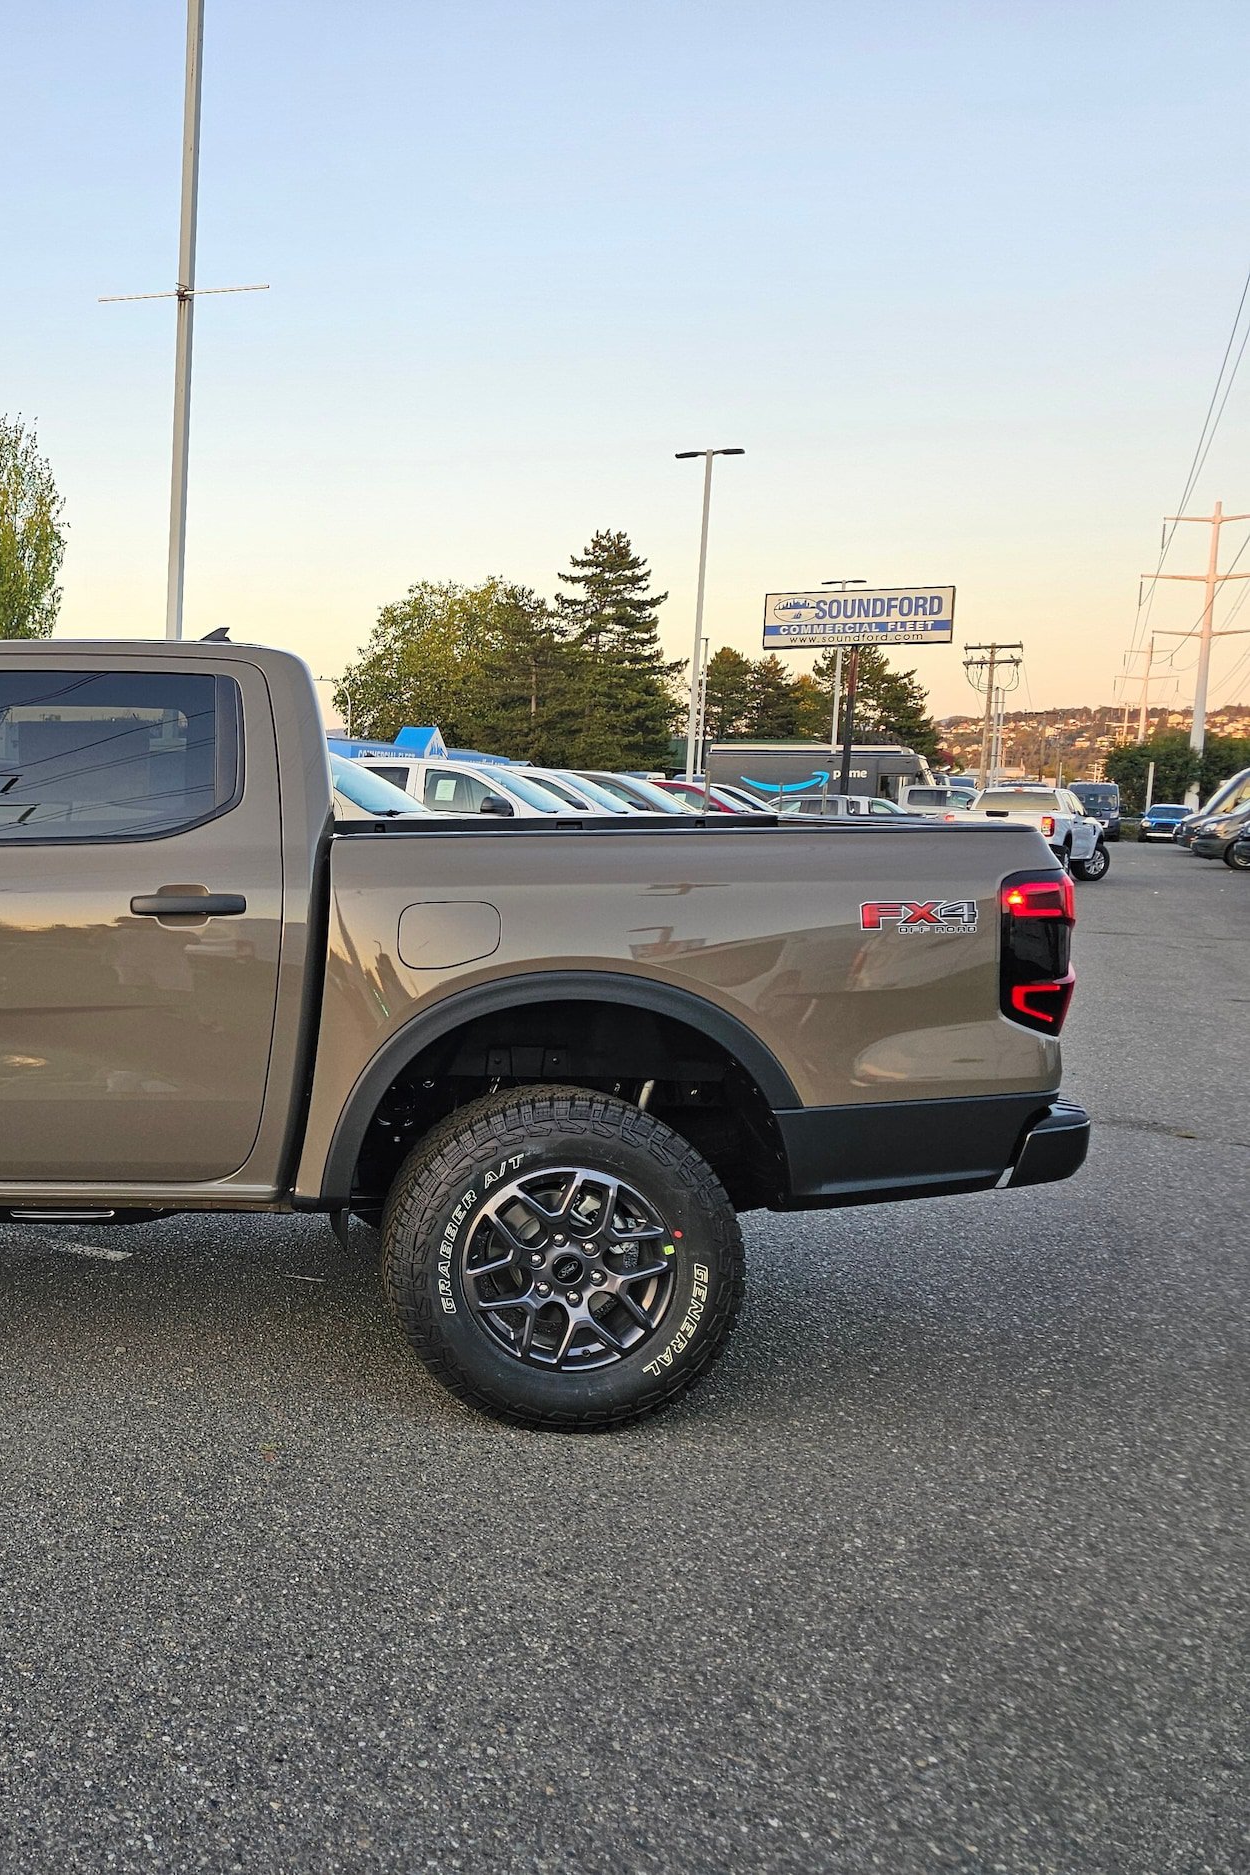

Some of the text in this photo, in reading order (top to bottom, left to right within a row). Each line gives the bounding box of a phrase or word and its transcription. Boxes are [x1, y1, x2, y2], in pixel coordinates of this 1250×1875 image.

[815, 595, 943, 620] SOUNDFORD
[779, 621, 934, 635] COMMERCIAL FLEET
[789, 632, 923, 644] www.soundford.com
[832, 769, 868, 780] pme
[860, 900, 978, 930] FX4
[898, 925, 977, 934] OFF ROAD
[436, 1189, 477, 1315] GRABBER
[643, 1262, 709, 1377] GENERAL
